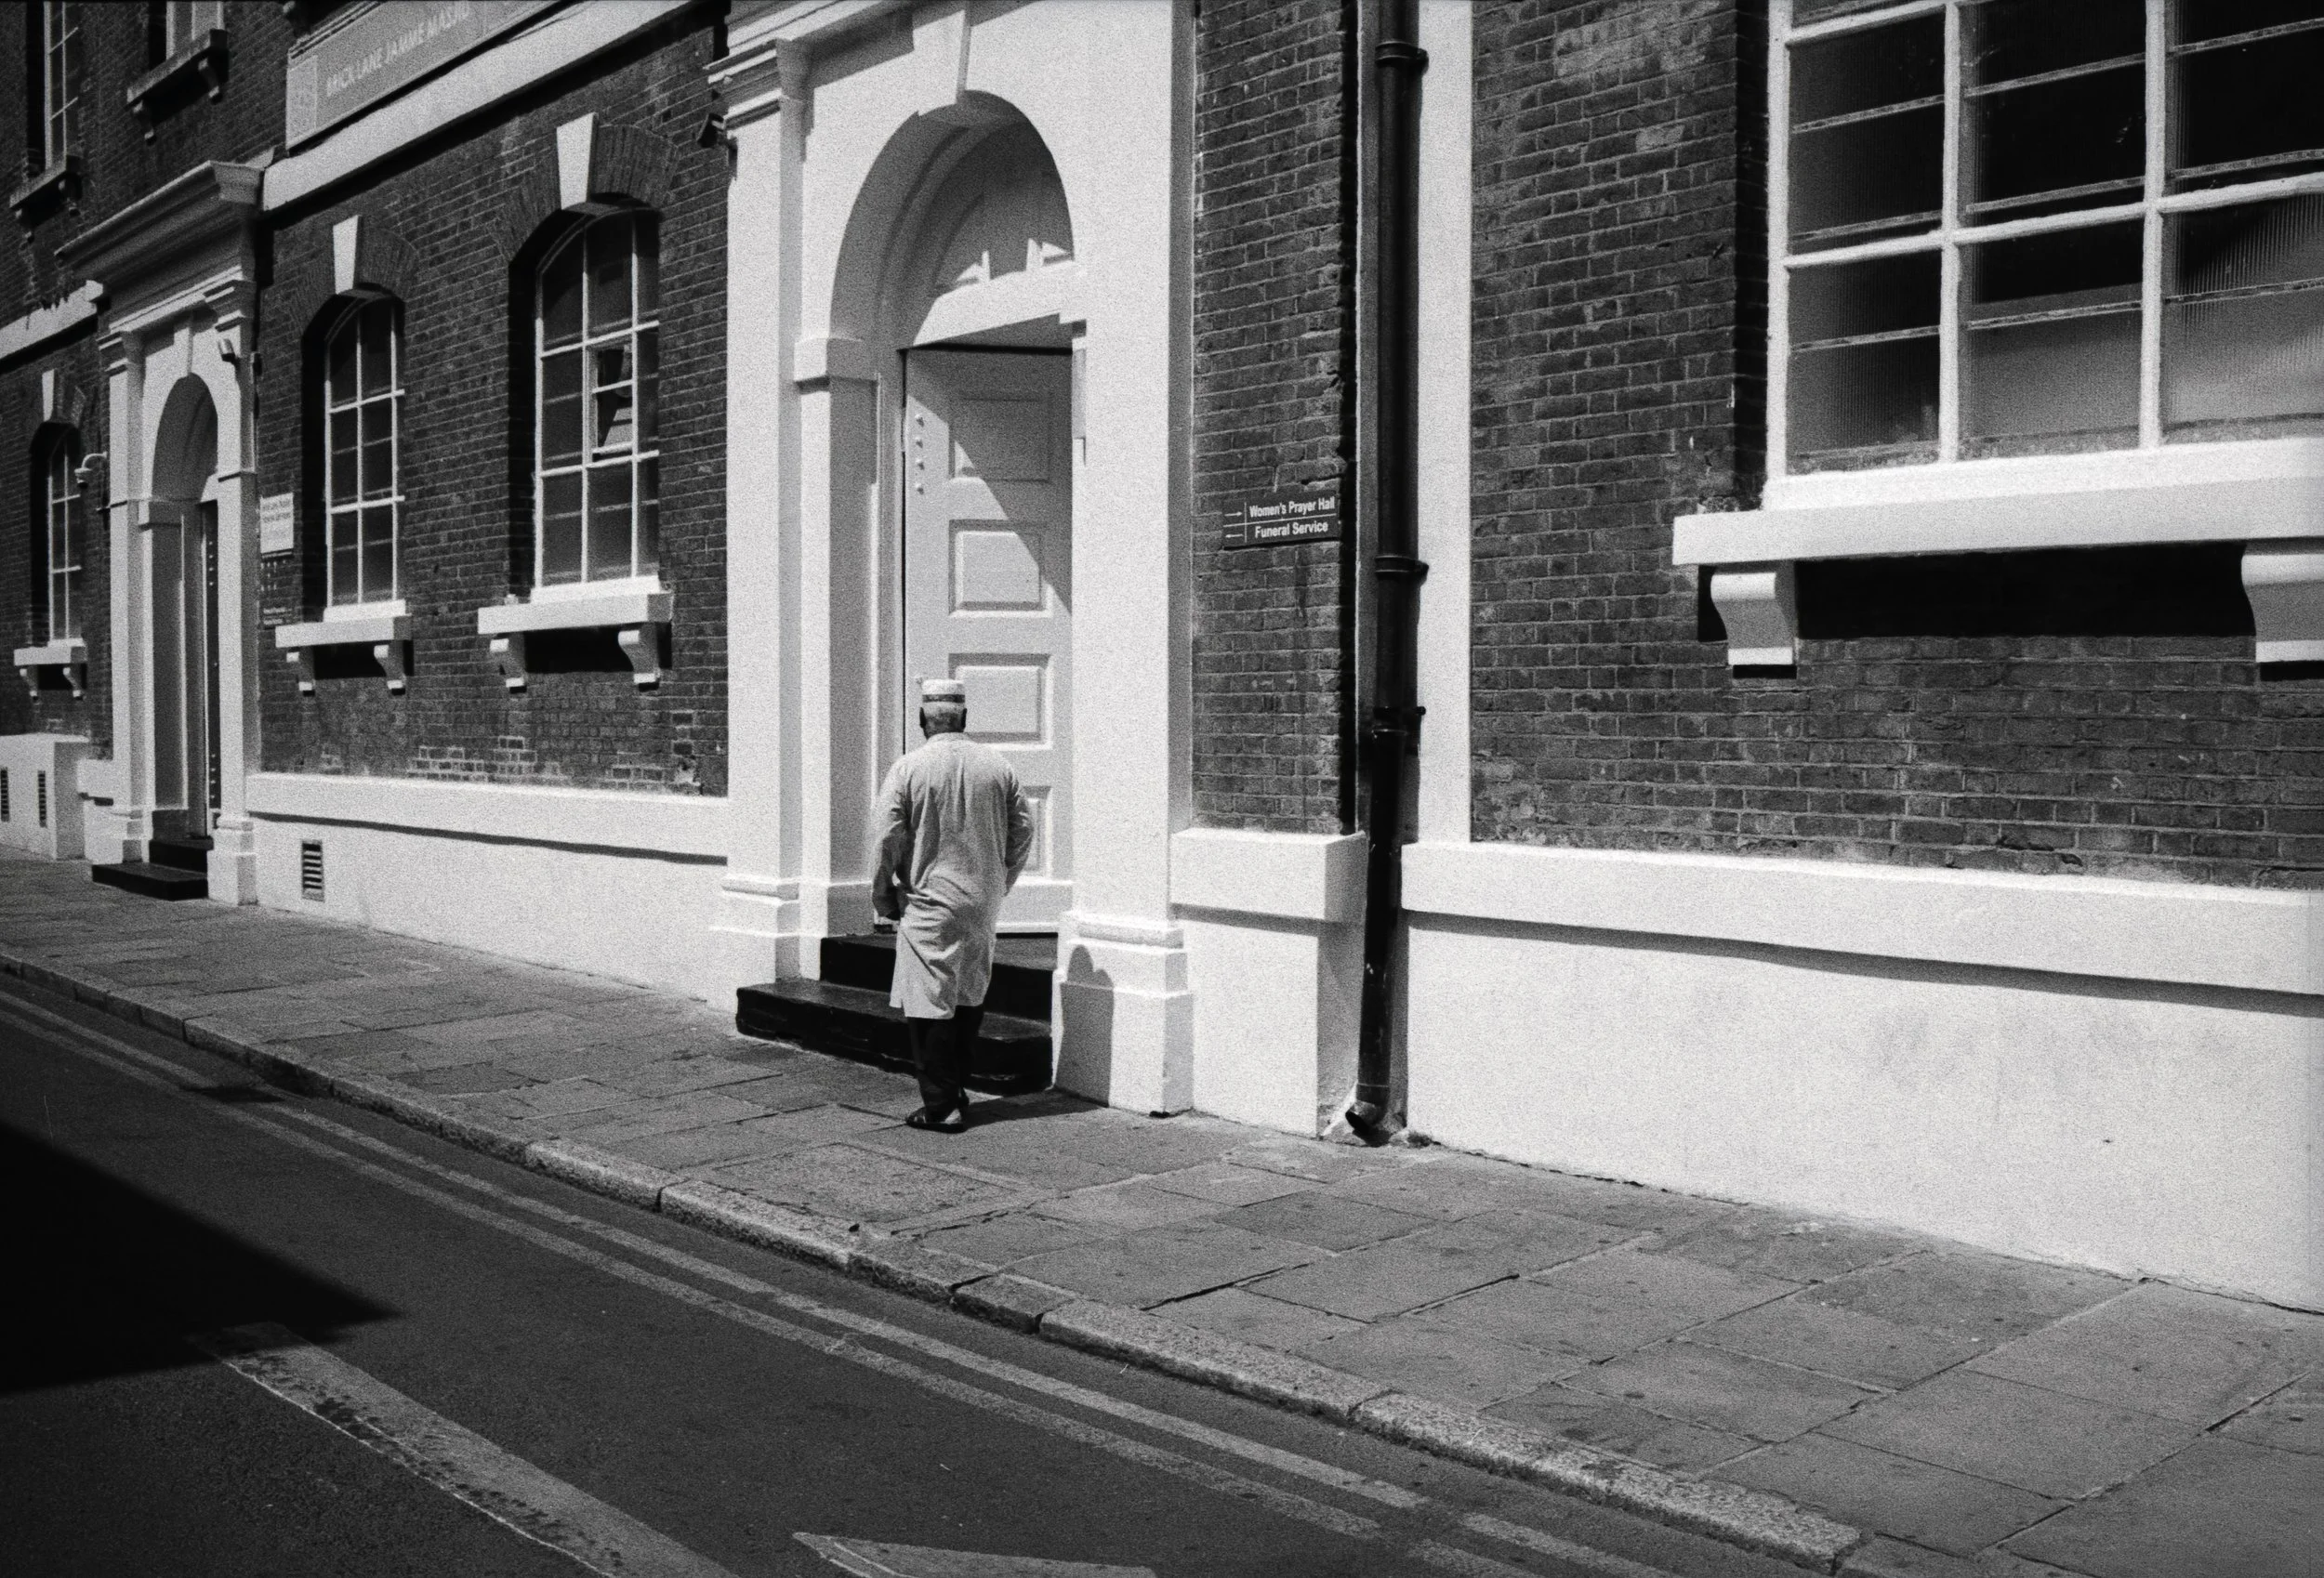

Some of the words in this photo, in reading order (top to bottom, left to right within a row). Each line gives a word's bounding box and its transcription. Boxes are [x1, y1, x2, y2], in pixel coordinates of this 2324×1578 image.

[356, 47, 383, 81] LANE
[1249, 502, 1287, 518] Women's
[1288, 500, 1316, 516] Prayer
[1318, 496, 1335, 510] Hall
[1255, 523, 1290, 539] Funeral
[1292, 519, 1328, 535] Service
